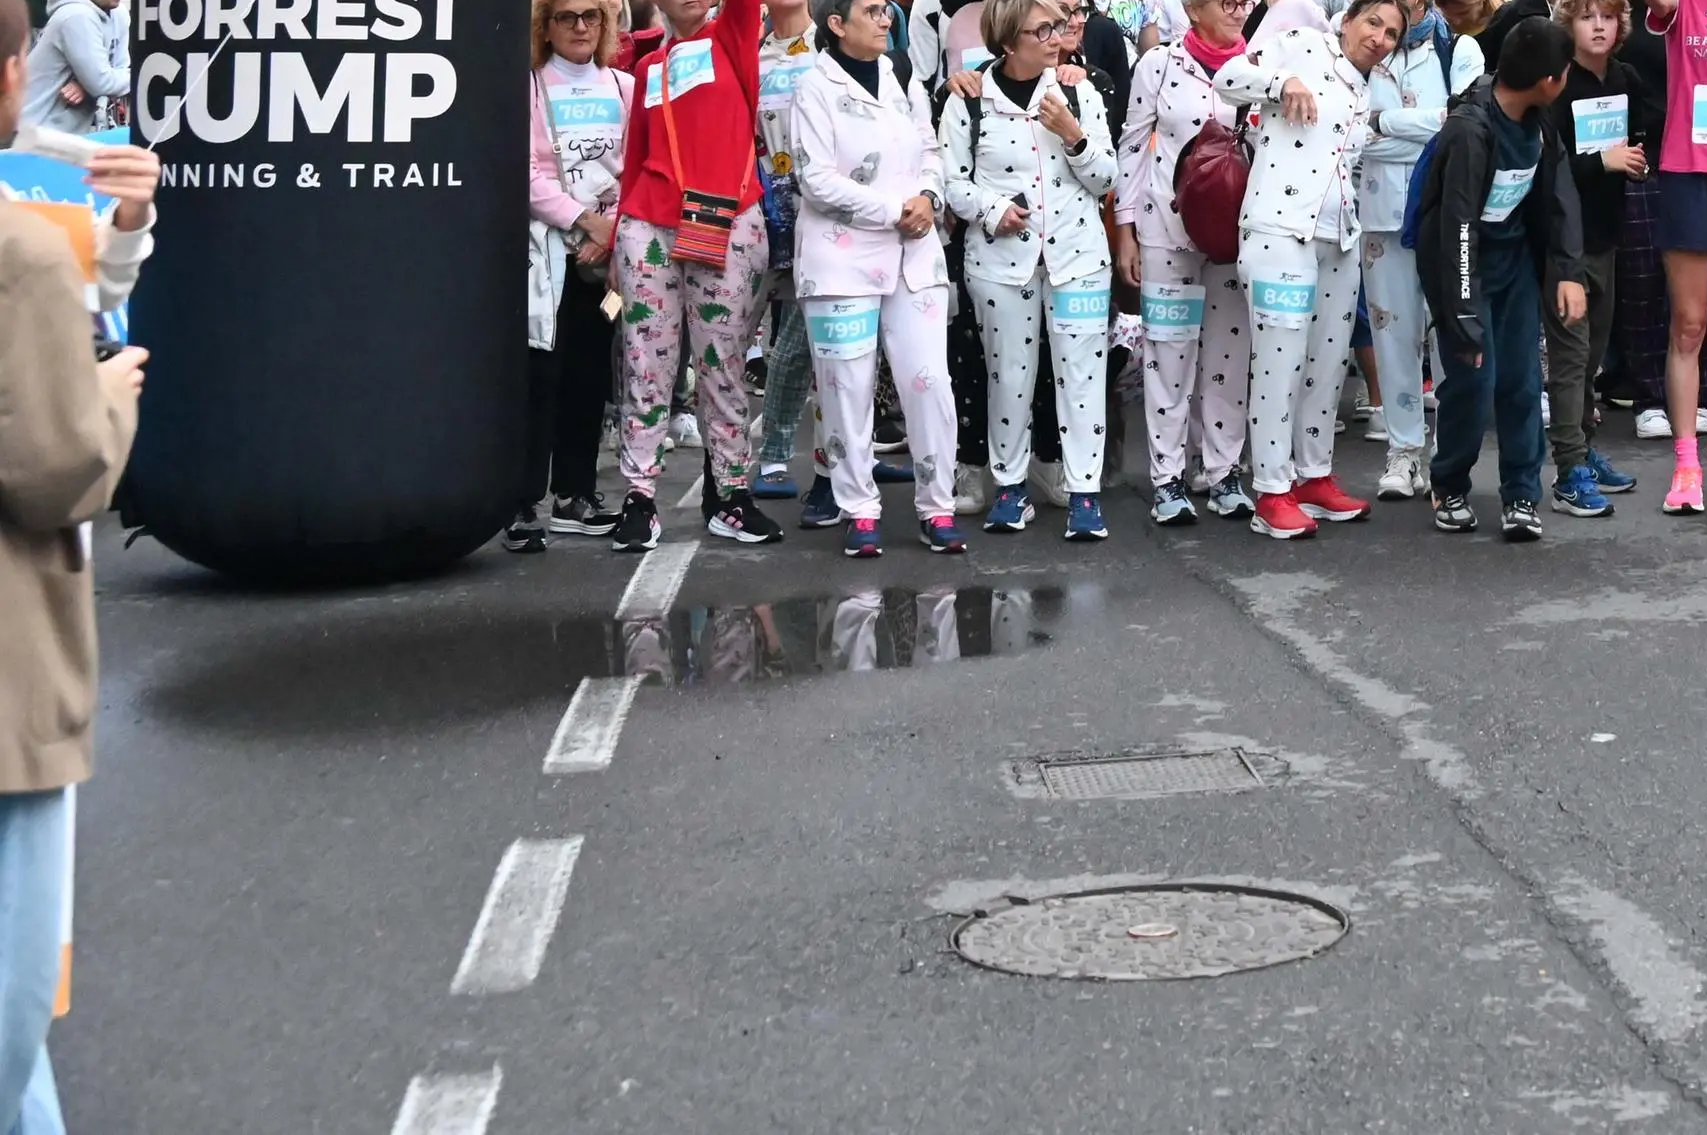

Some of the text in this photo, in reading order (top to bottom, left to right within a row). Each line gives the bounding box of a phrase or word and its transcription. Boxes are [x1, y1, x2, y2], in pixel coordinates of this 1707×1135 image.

[138, 49, 457, 143] GUMP
[558, 102, 610, 120] 7674
[1587, 115, 1625, 136] 7775
[162, 163, 462, 188] NNING & TRAIL
[1459, 223, 1471, 300] THE NORTH FACE
[1068, 295, 1107, 314] 8103
[1264, 287, 1309, 308] 8432
[1146, 302, 1190, 321] 7962
[823, 317, 867, 339] 7991
